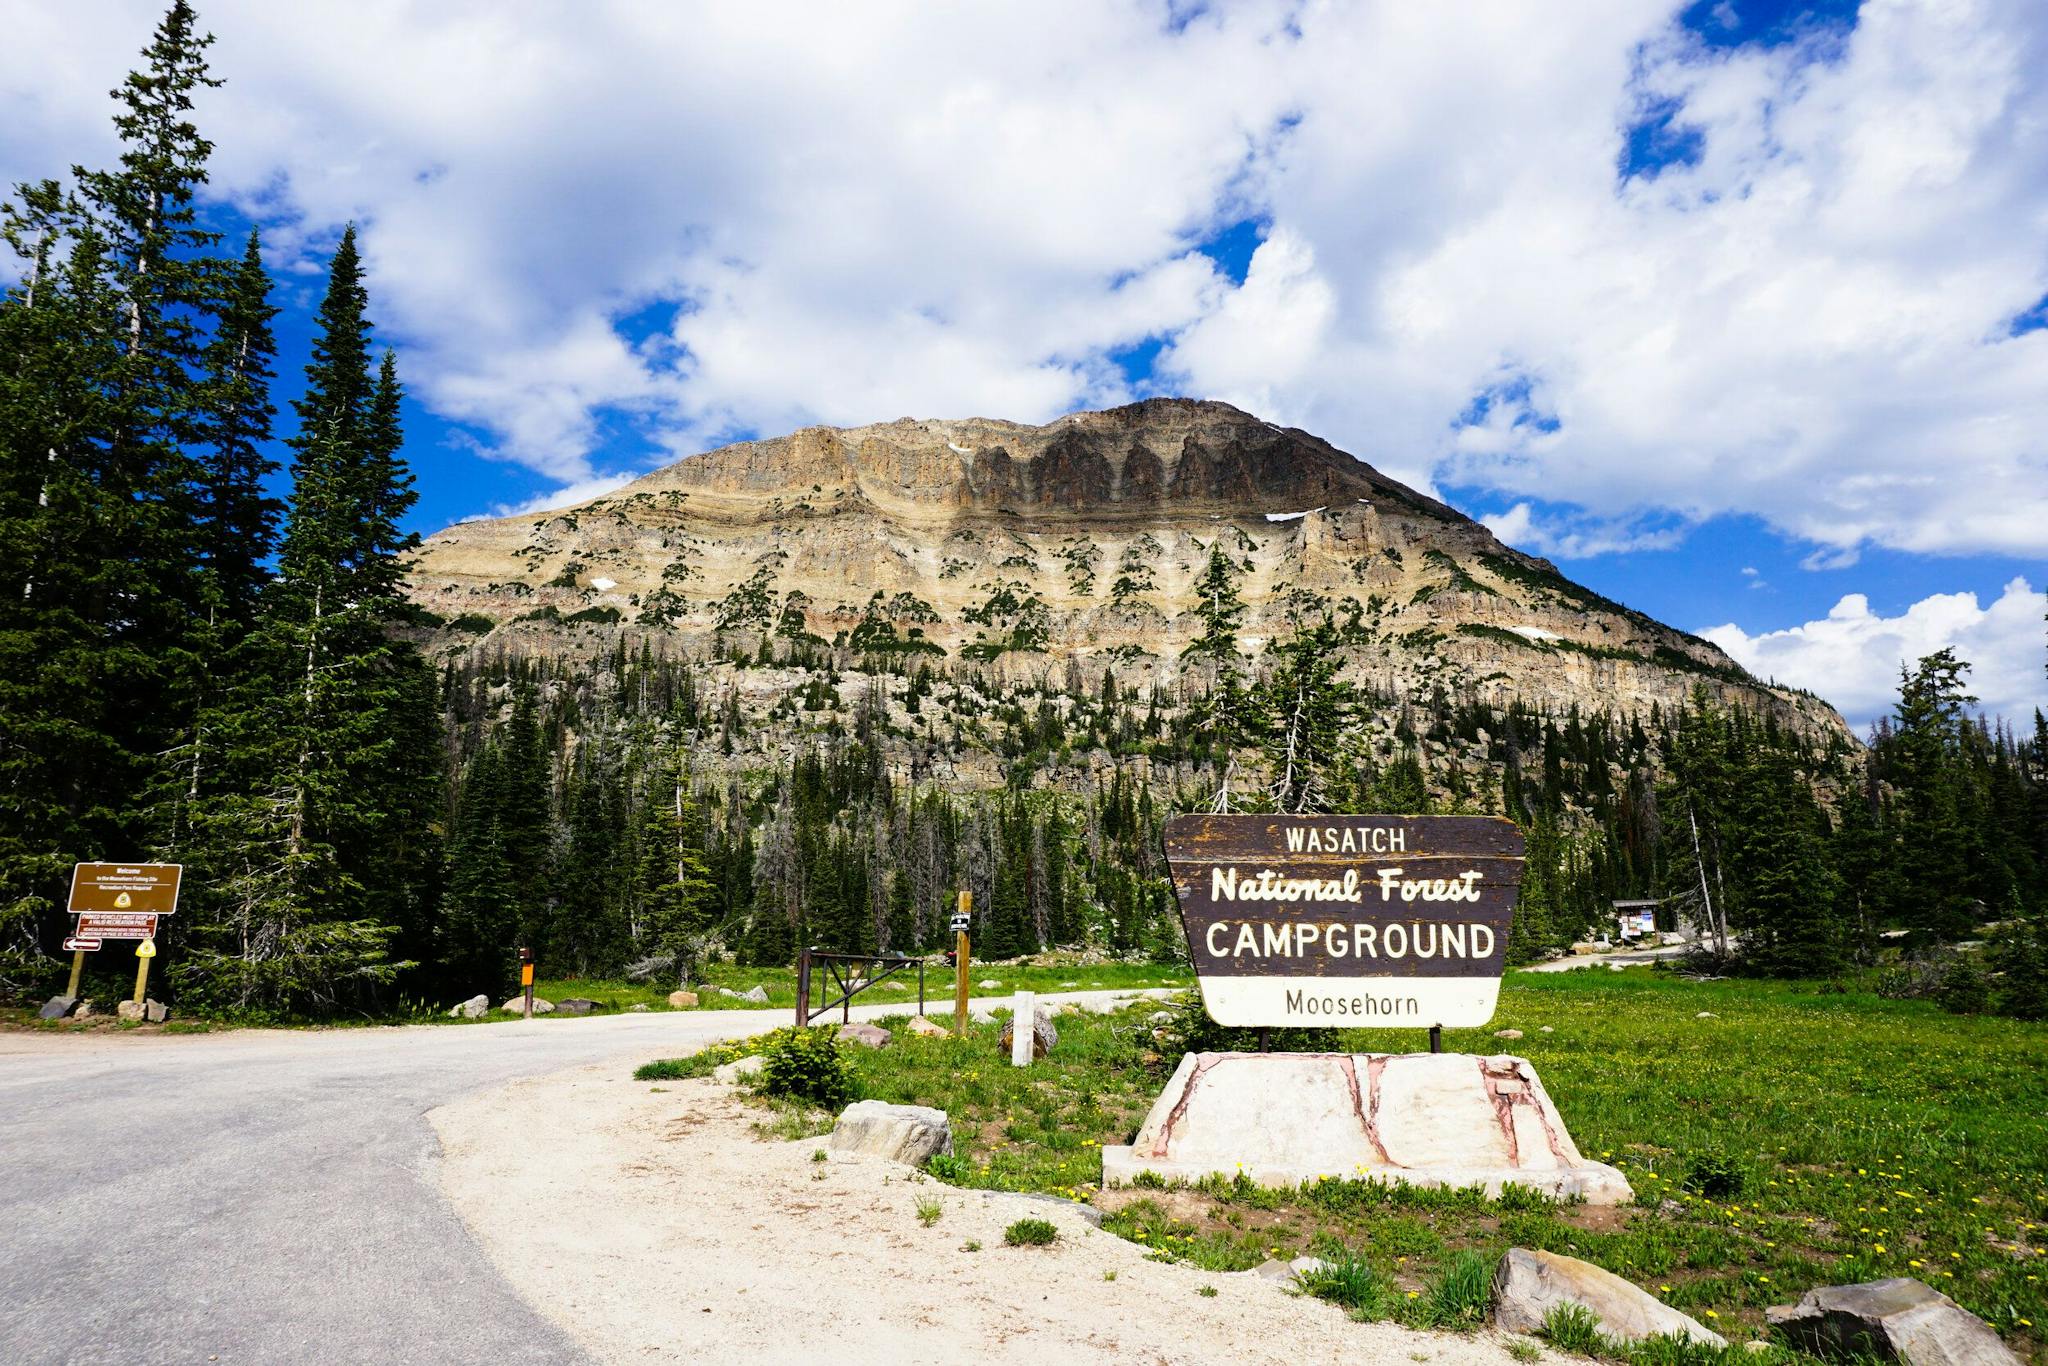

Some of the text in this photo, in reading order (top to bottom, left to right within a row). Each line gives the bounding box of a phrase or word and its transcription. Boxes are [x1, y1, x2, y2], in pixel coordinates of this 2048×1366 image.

[1286, 827, 1405, 852] WASATCH
[1211, 867, 1483, 902] National Forest
[1206, 922, 1495, 959] CAMPGROUND
[1286, 989, 1418, 1015] Moosehorn
